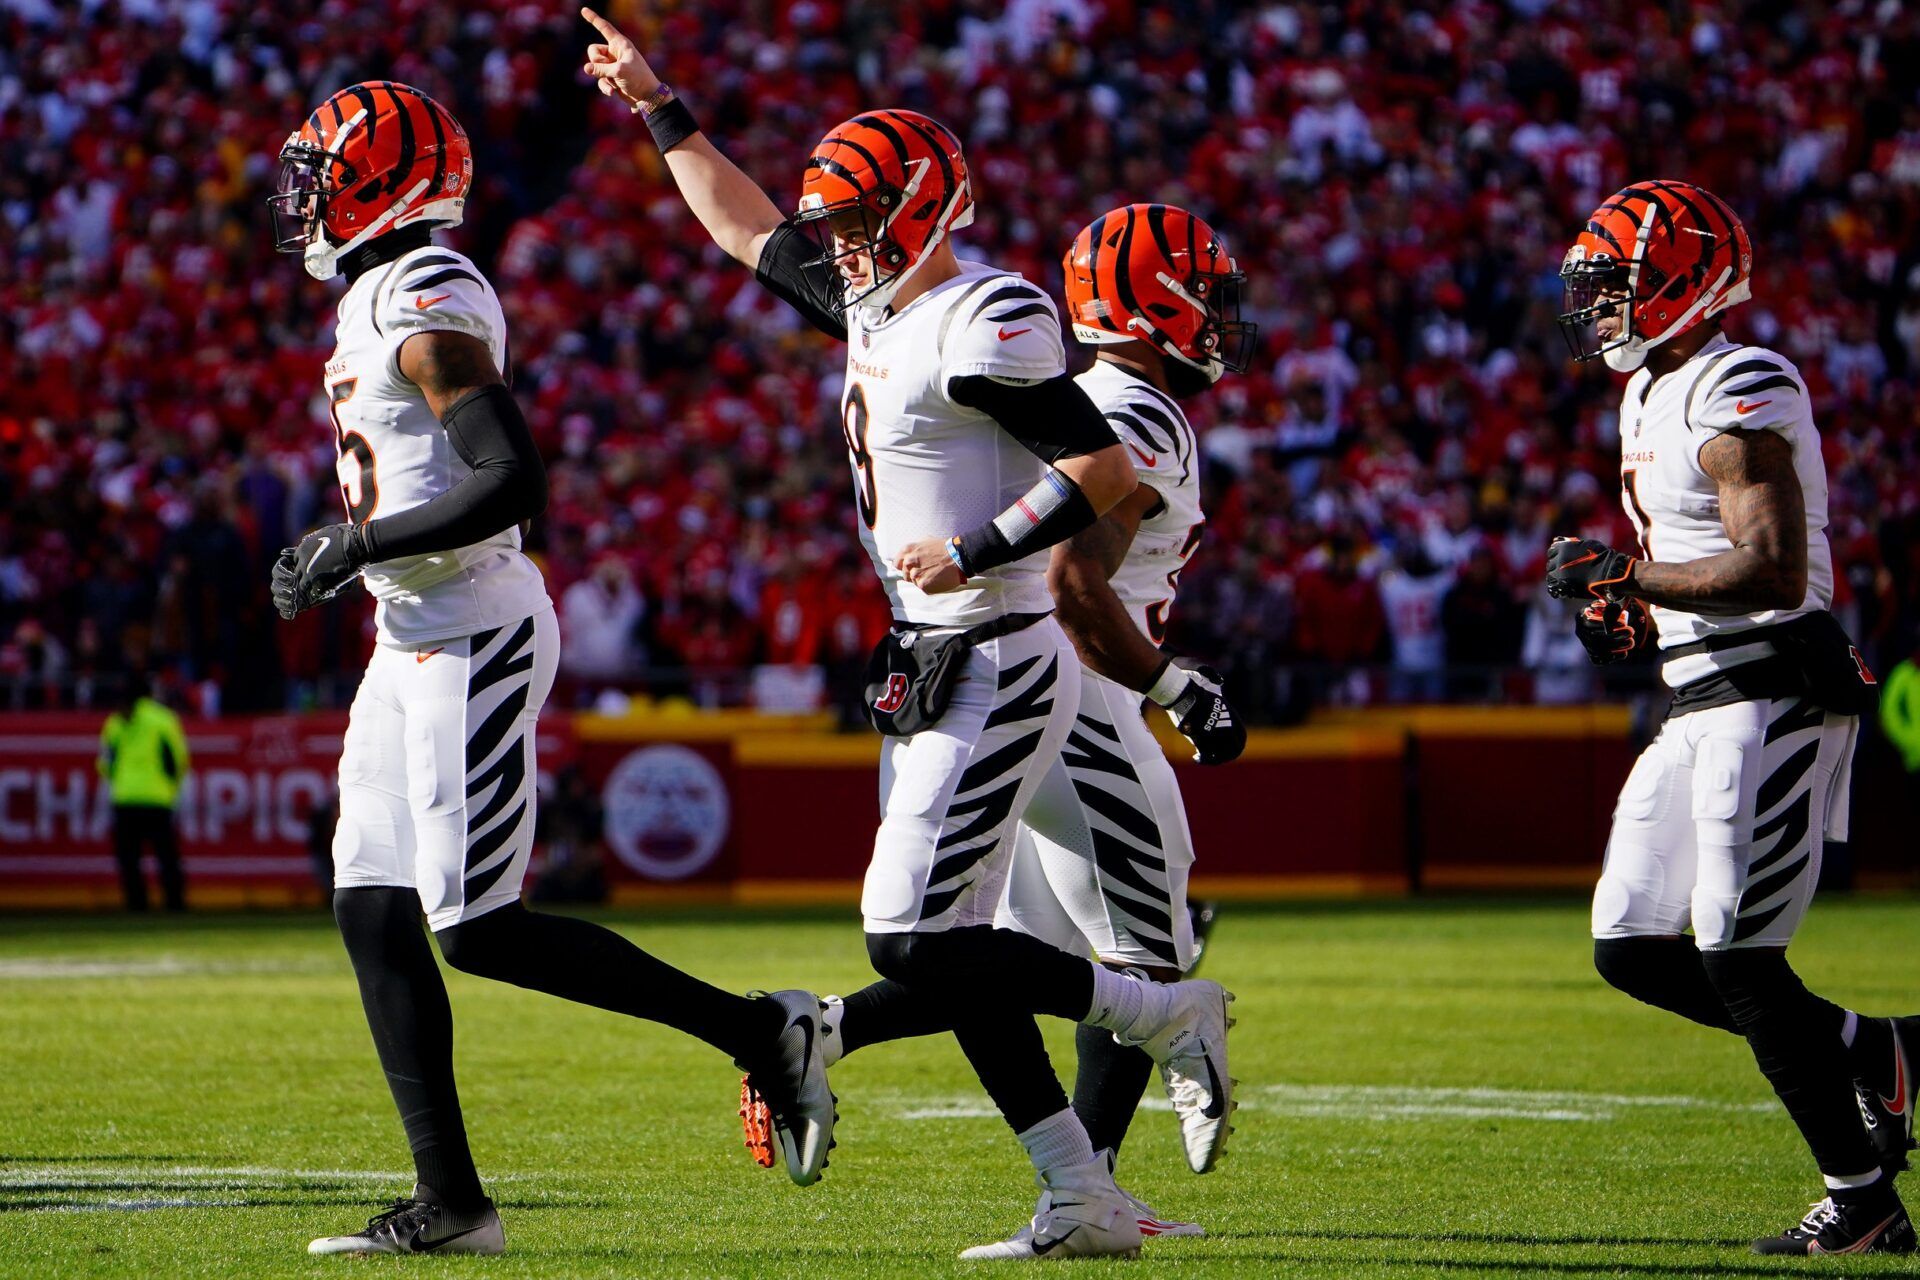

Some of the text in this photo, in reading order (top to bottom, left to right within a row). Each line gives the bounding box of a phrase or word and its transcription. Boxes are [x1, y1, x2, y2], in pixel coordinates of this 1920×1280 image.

[844, 381, 877, 530] 9
[1204, 697, 1222, 731] adidas
[0, 767, 340, 842] CHPIO
[1168, 1030, 1190, 1049] ALPHA
